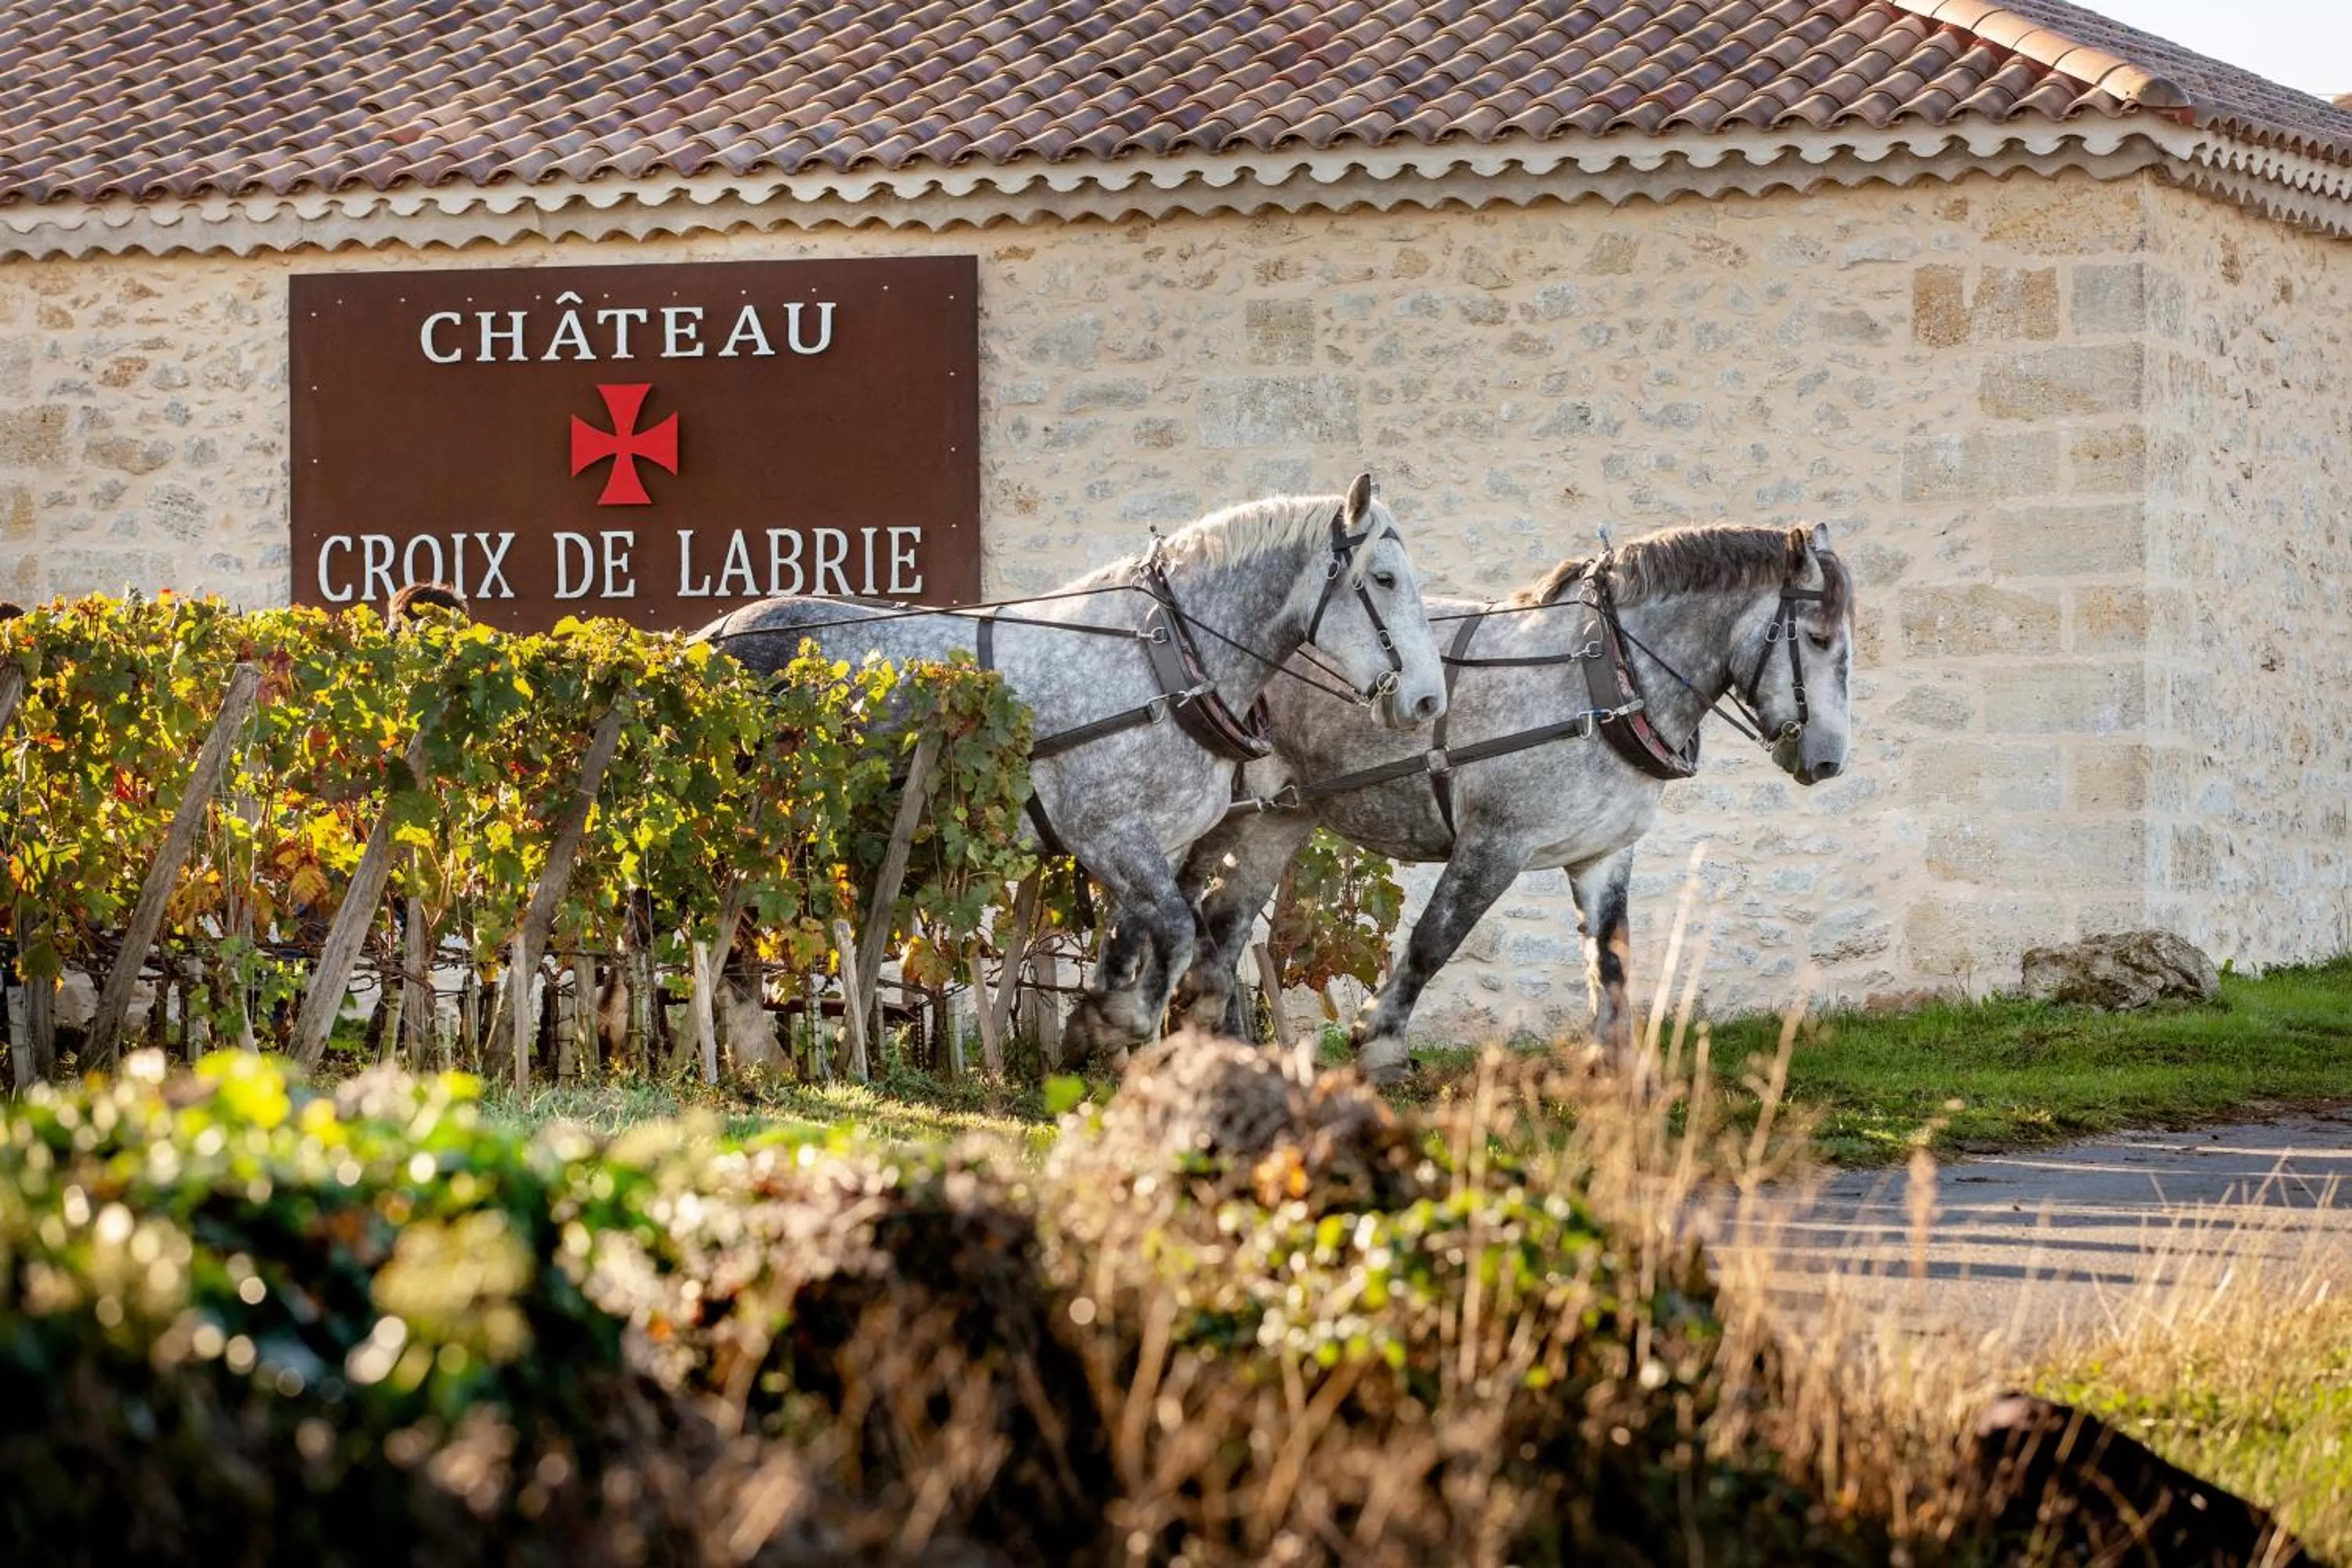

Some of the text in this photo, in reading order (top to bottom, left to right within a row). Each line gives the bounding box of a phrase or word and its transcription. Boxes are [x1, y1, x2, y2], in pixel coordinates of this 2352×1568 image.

[420, 291, 837, 363] CHÂTEAU
[318, 526, 922, 602] CROIX DE LABRIE
